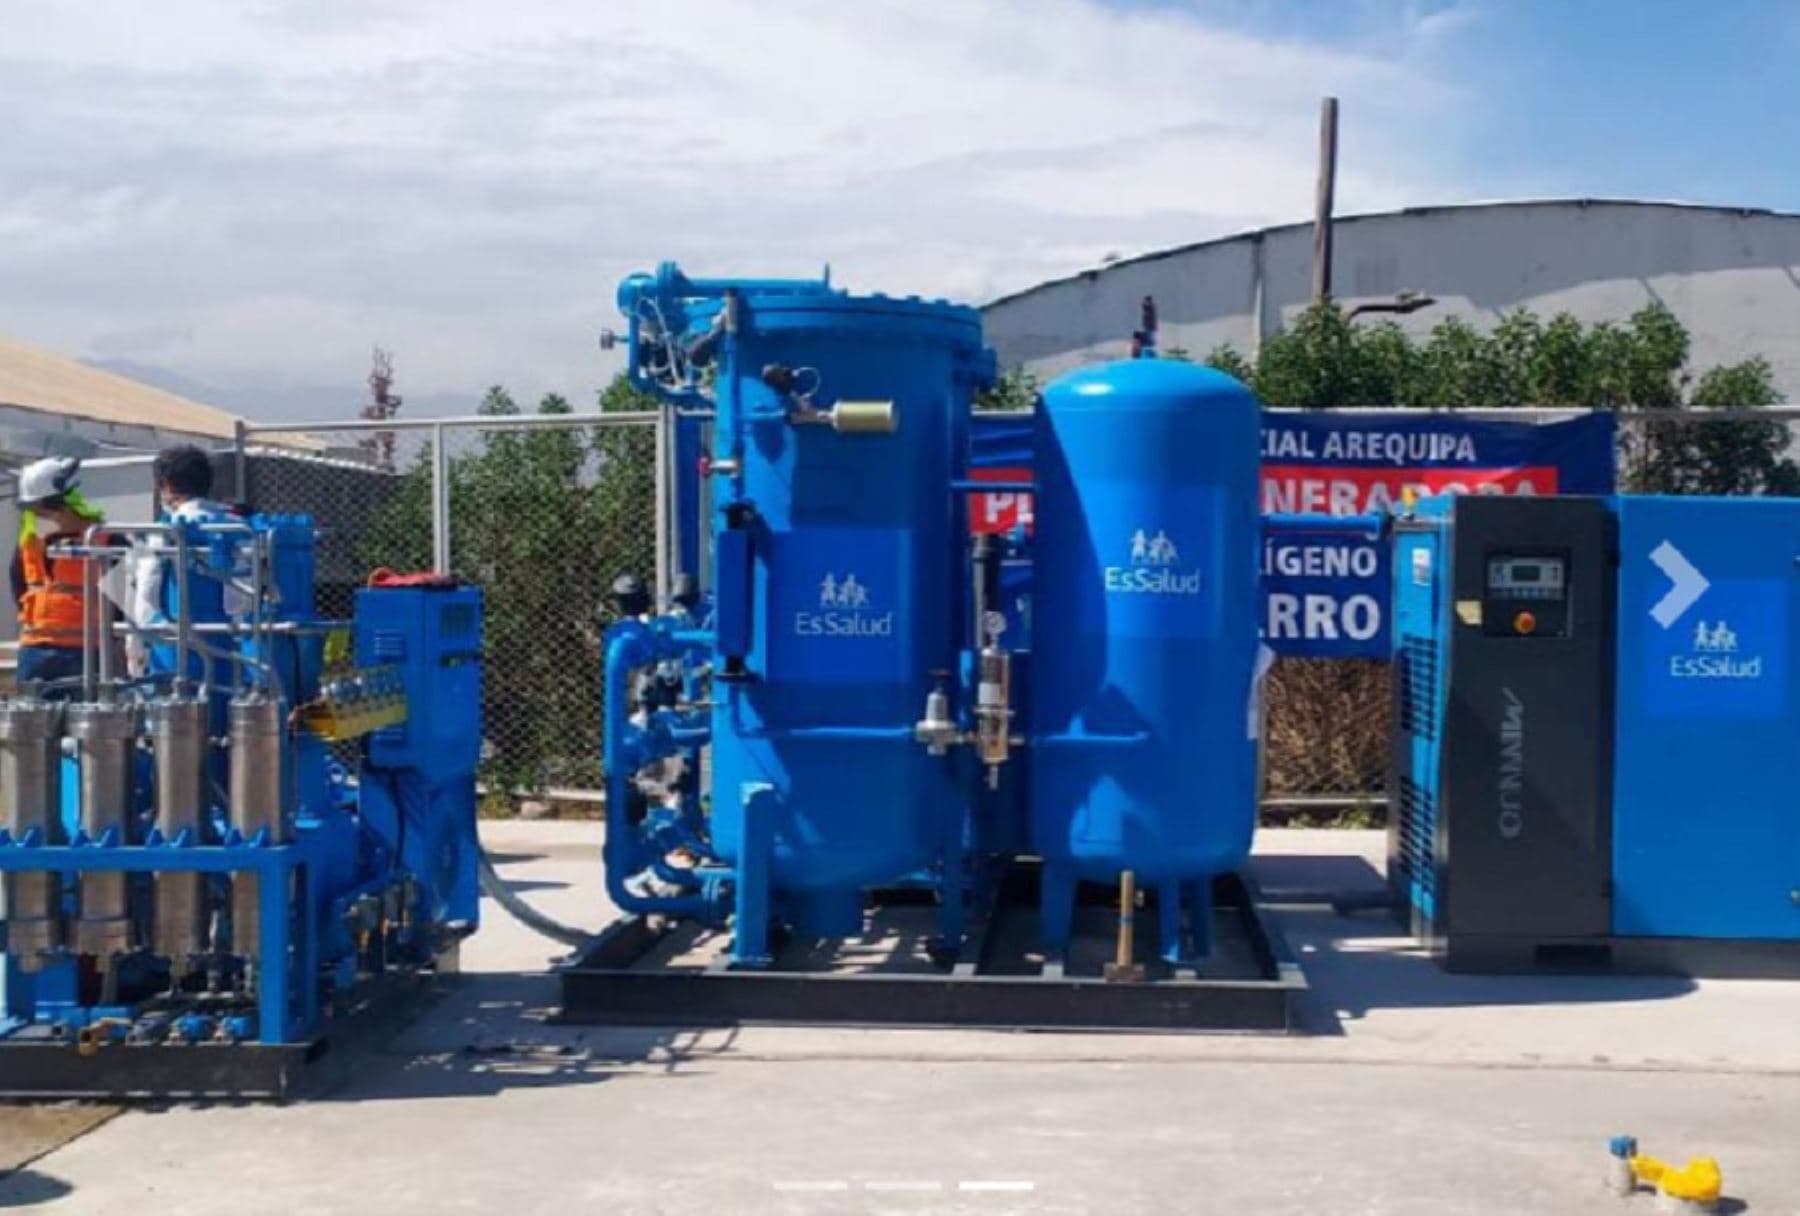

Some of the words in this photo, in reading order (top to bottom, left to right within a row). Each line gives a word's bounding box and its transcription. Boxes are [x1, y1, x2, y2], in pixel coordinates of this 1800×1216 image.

[1322, 431, 1476, 464] AREQUIPA
[1259, 537, 1378, 577] ÍGENO
[1105, 566, 1200, 595] EsSalud
[795, 611, 891, 636] EsSalud
[1258, 592, 1380, 641] RRO
[1670, 656, 1762, 678] EsSalud
